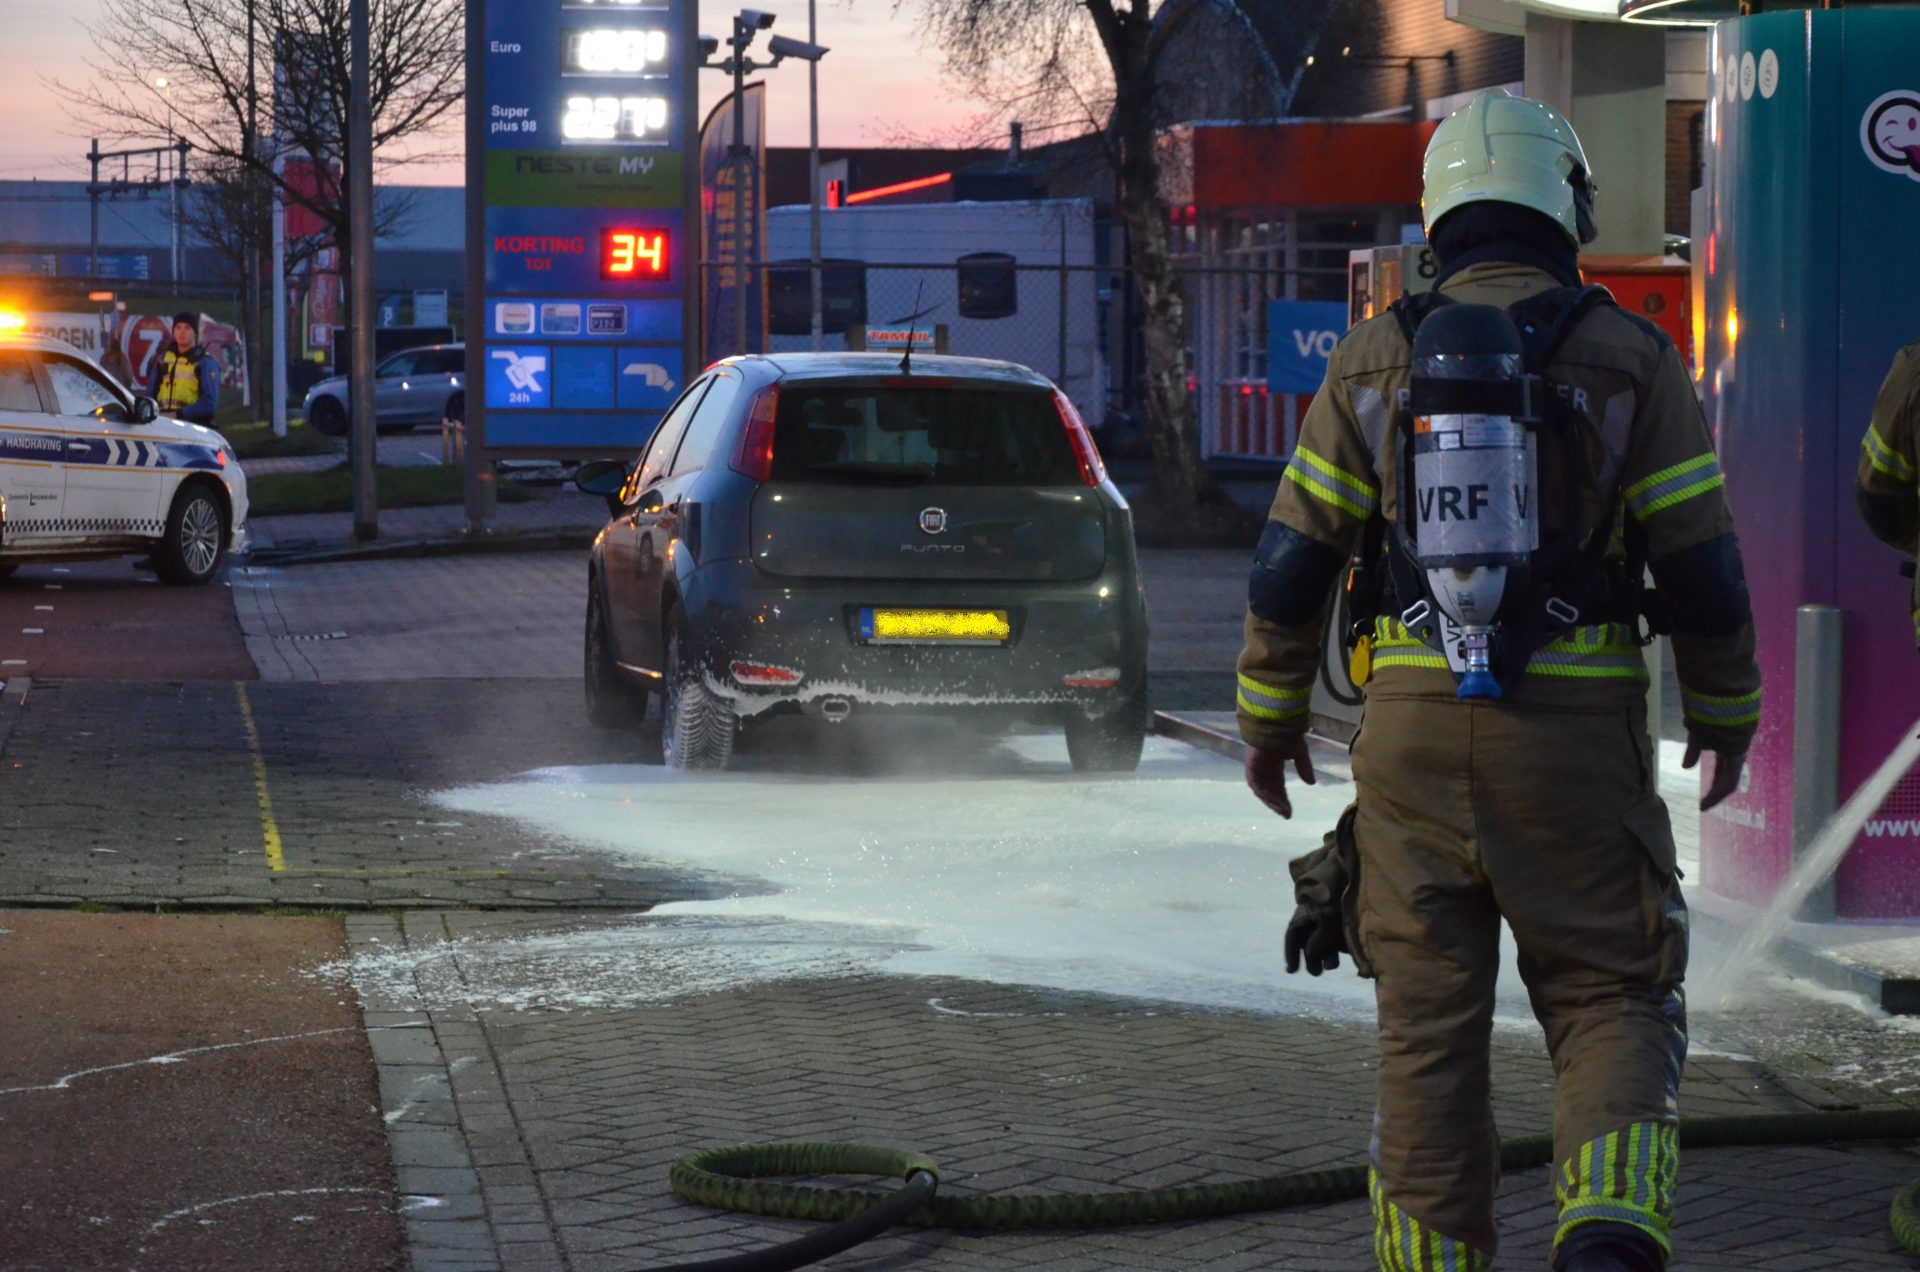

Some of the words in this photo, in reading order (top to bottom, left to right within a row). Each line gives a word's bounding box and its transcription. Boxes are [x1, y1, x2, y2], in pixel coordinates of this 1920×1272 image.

[490, 41, 521, 53] Euro
[491, 105, 529, 118] Super
[491, 120, 518, 133] plus
[521, 120, 537, 132] 98
[516, 156, 612, 174] NESTE
[618, 156, 654, 175] MY
[494, 236, 585, 254] KORTING
[610, 234, 662, 271] 34
[526, 258, 552, 271] TOT
[1418, 249, 1438, 279] 8
[591, 318, 615, 329] PIN
[139, 329, 163, 377] 7
[509, 391, 530, 403] 24h
[6, 437, 62, 452] HANDHAVING
[1418, 484, 1489, 523] VRF
[925, 513, 941, 527] FIAT
[900, 544, 966, 553] PUNTO
